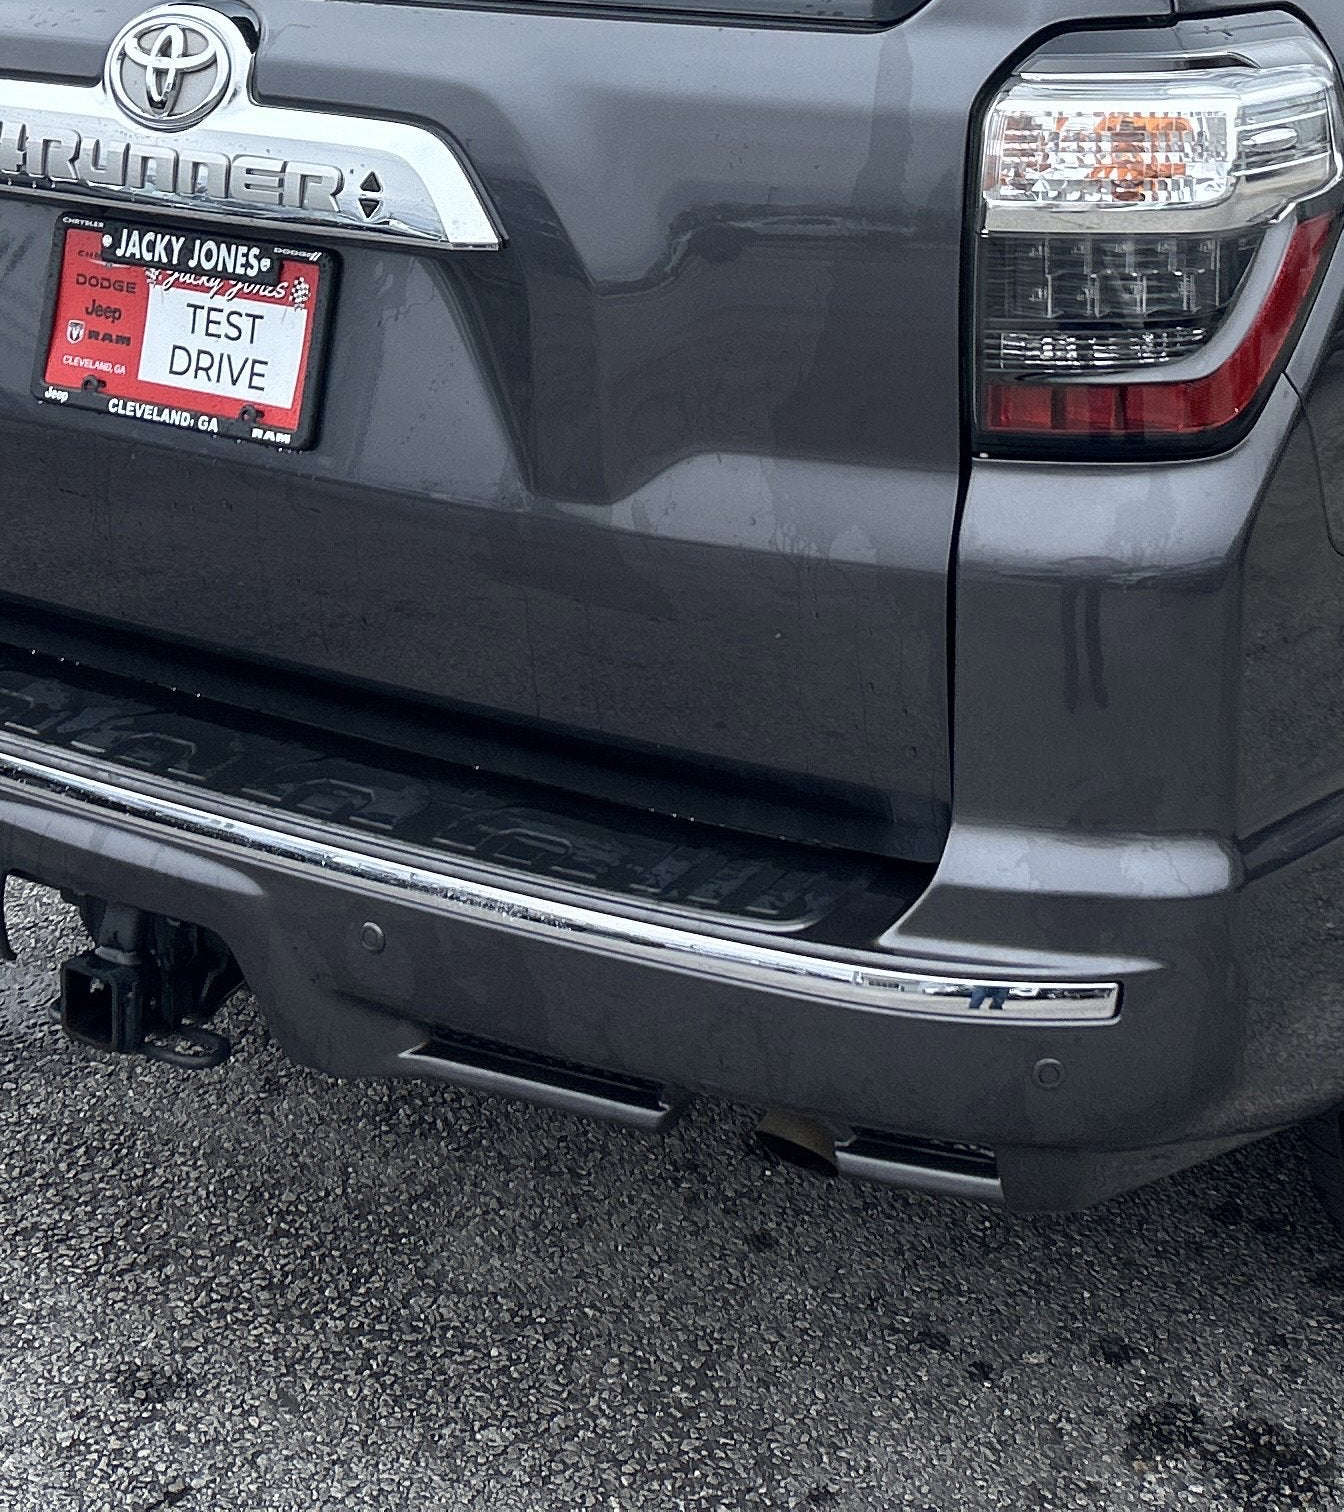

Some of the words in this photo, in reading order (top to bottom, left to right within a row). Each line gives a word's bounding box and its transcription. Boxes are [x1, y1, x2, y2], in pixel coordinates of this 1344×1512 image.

[116, 228, 185, 264] JACKY
[188, 239, 260, 277] JONES
[76, 273, 137, 294] DODGE
[85, 299, 122, 324] Jeep
[186, 302, 264, 345] TEST
[87, 330, 131, 346] RAM
[63, 355, 113, 373] CLEVELAND,
[114, 363, 126, 375] GA
[169, 344, 269, 392] DRIVE
[44, 386, 69, 403] Jeep
[108, 397, 195, 427] CLEVELAND,
[197, 415, 219, 433] GA
[251, 427, 291, 444] RAM
